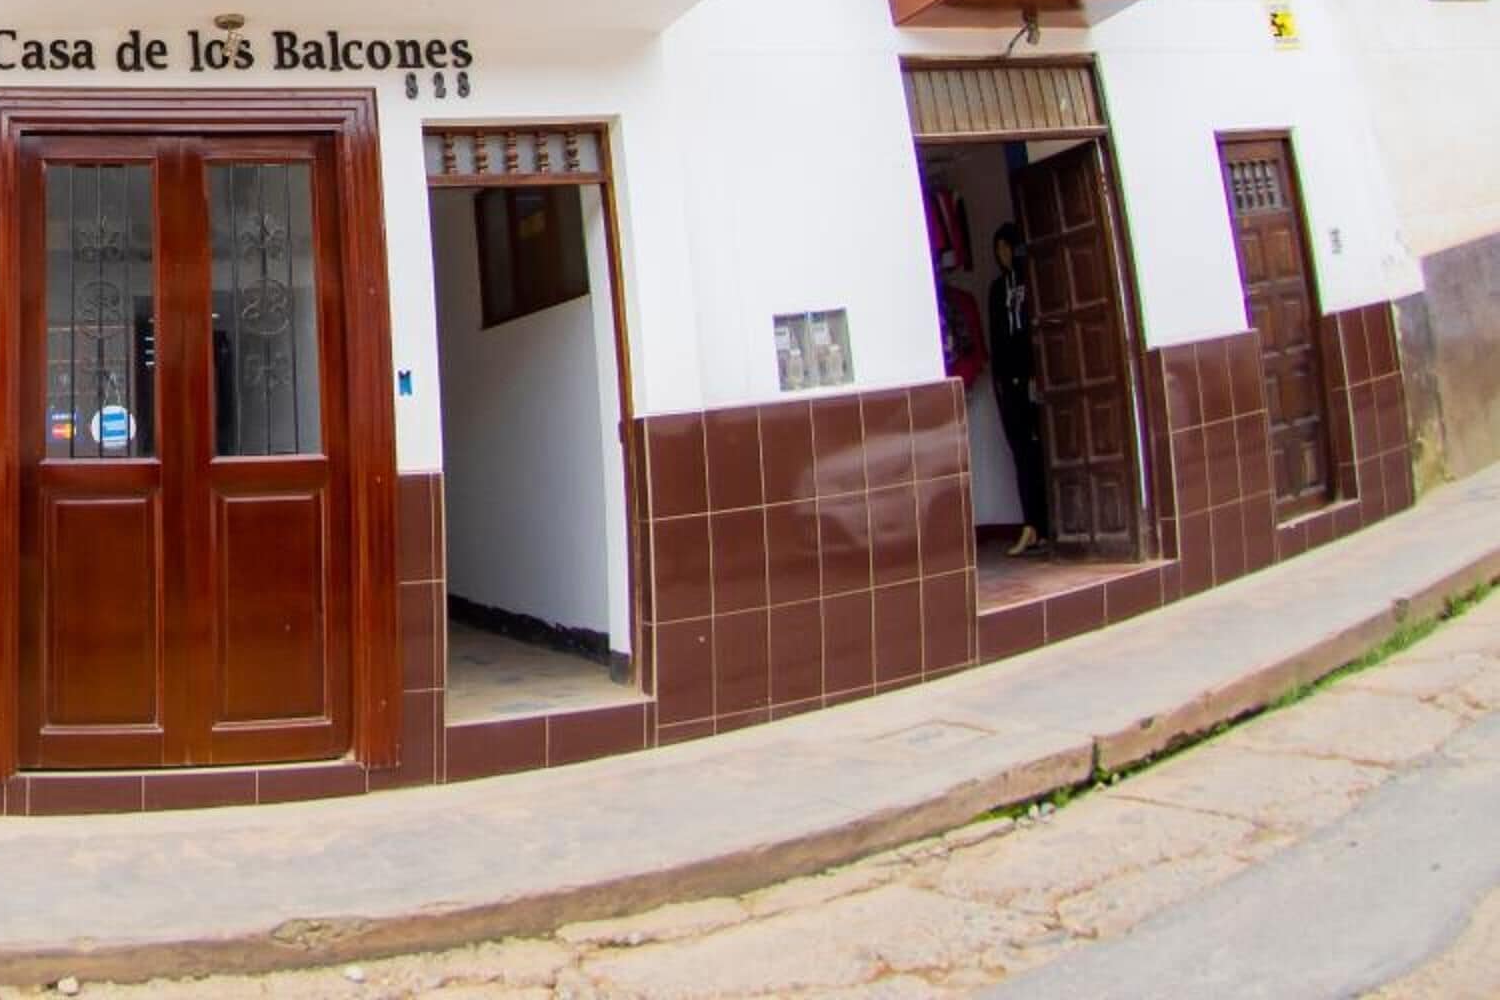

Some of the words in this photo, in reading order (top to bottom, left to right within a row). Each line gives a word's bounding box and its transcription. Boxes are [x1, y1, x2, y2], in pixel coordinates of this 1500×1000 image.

[115, 30, 169, 73] de
[187, 30, 255, 73] los
[271, 30, 474, 72] Balcones
